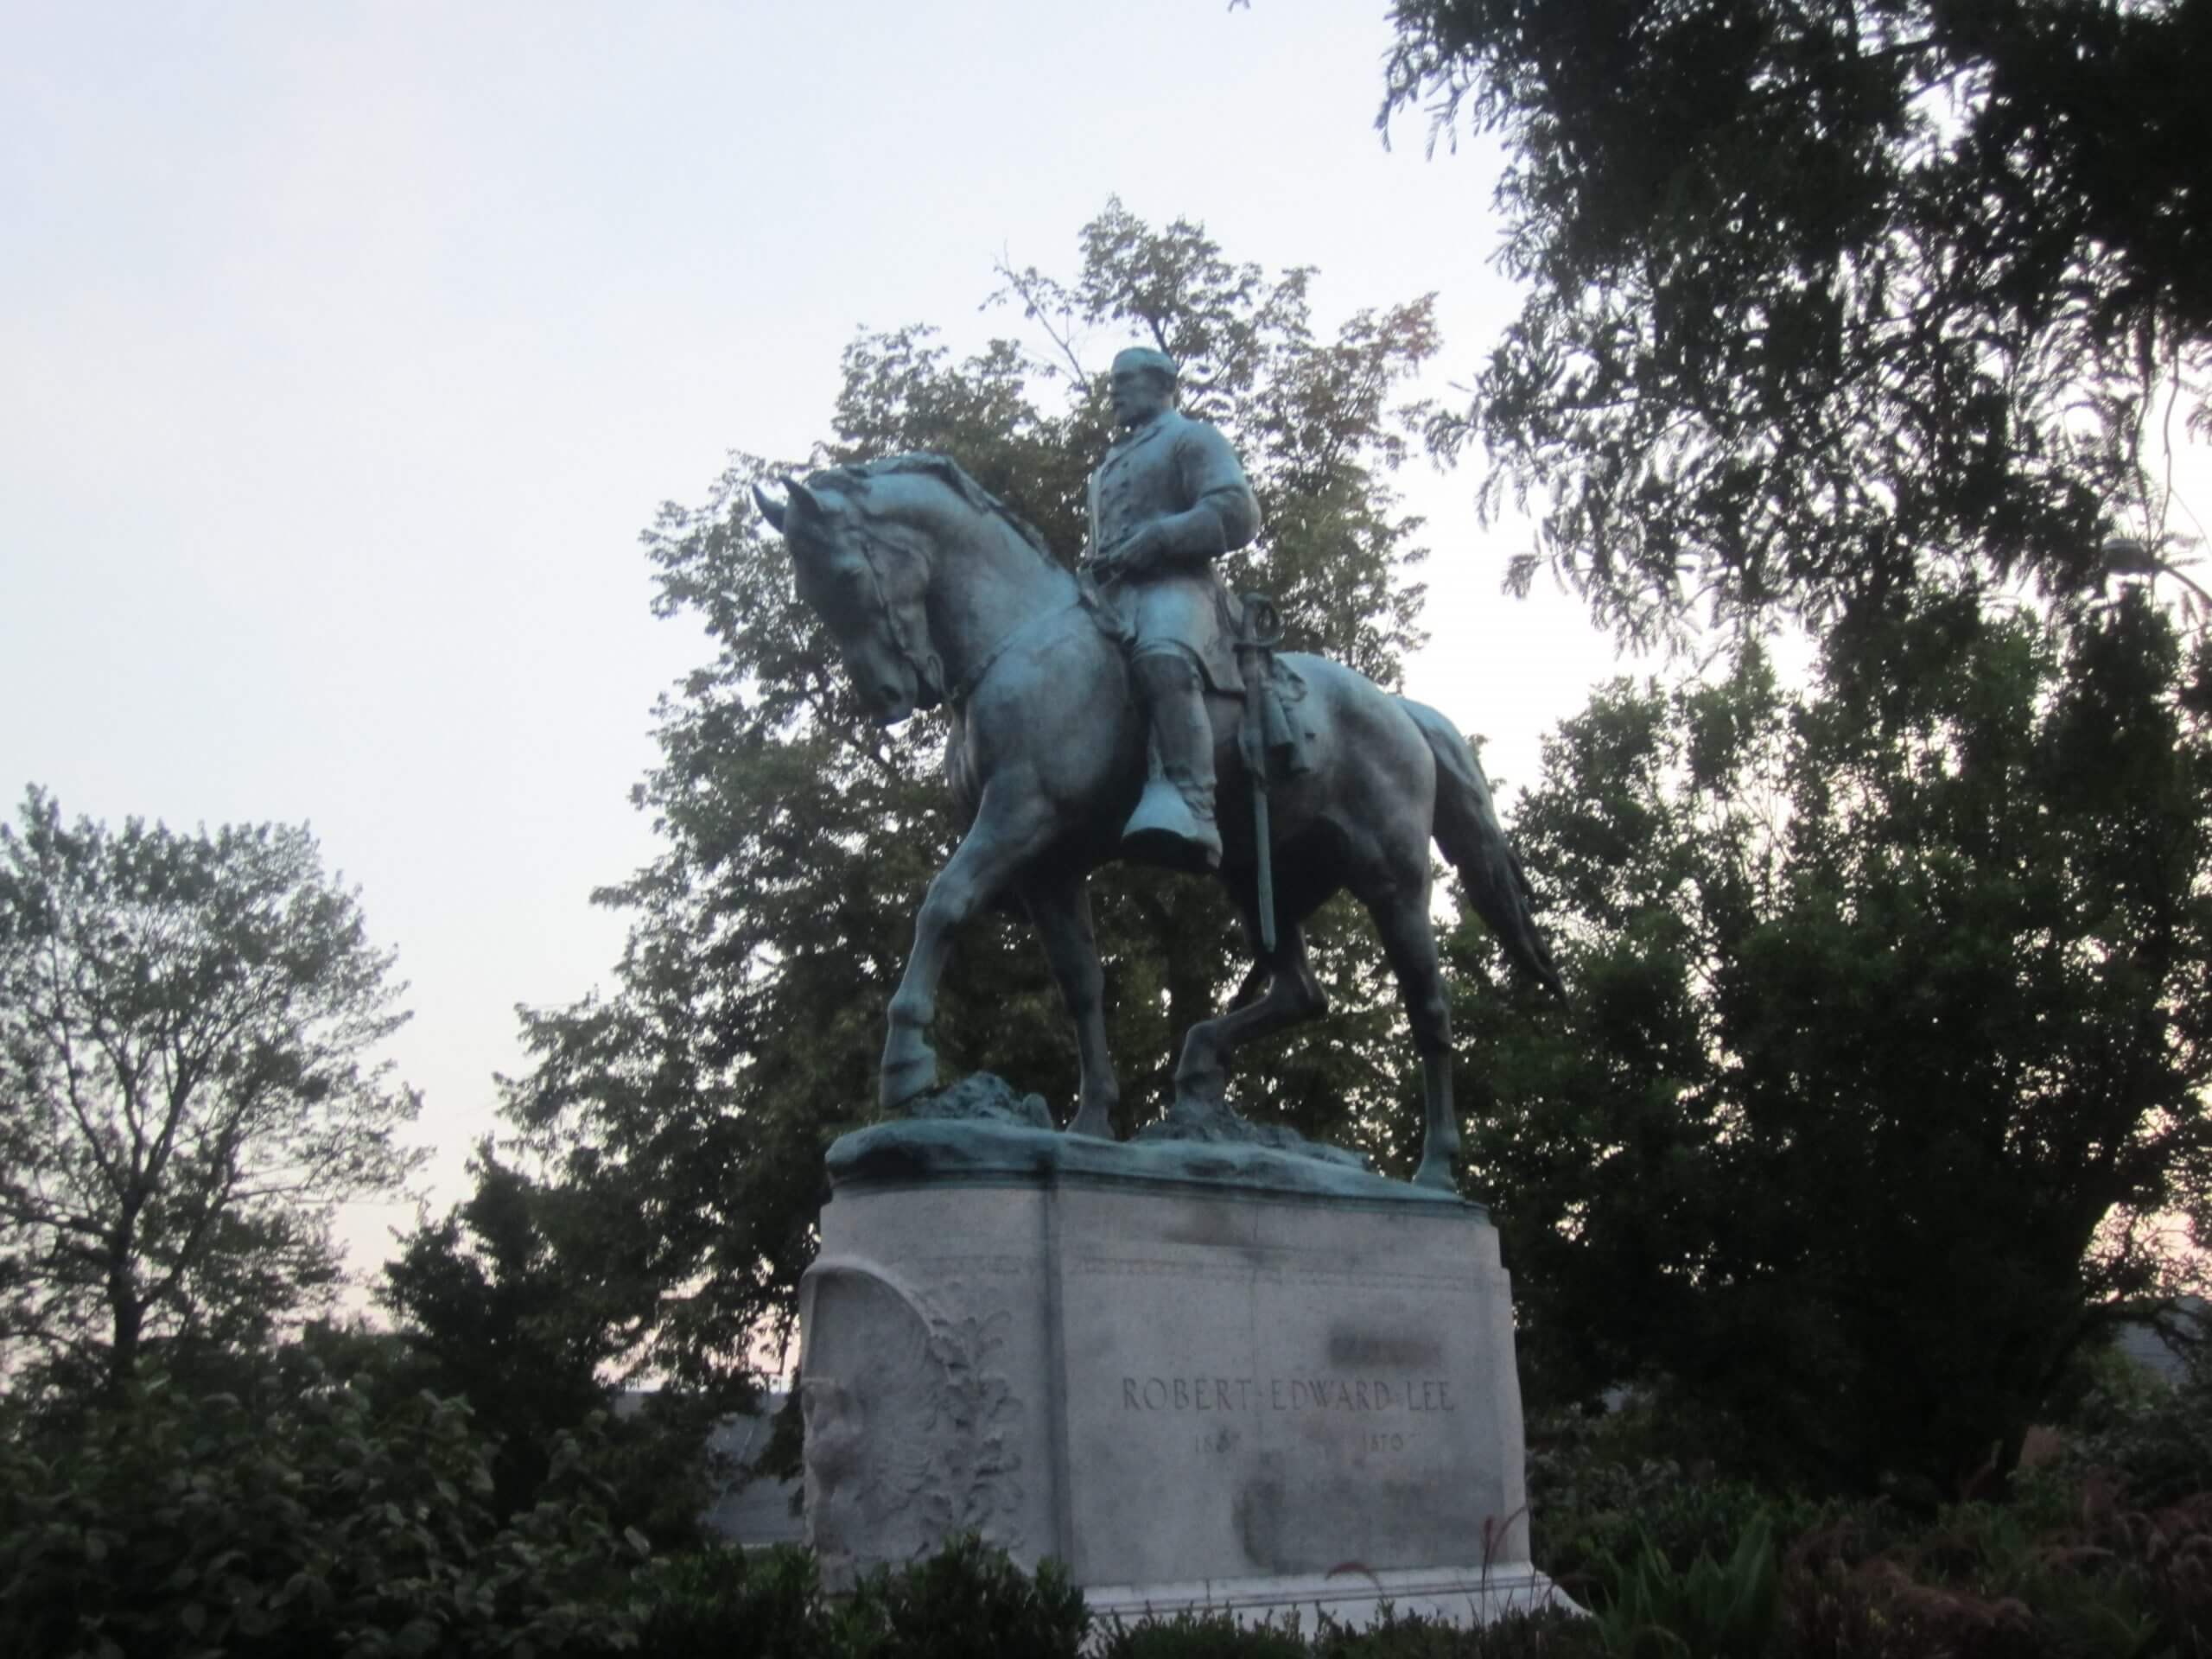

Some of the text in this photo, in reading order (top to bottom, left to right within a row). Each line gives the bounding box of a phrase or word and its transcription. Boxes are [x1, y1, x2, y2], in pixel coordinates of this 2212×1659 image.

[1122, 1377, 1455, 1411] ROBERT EDWARD LEE
